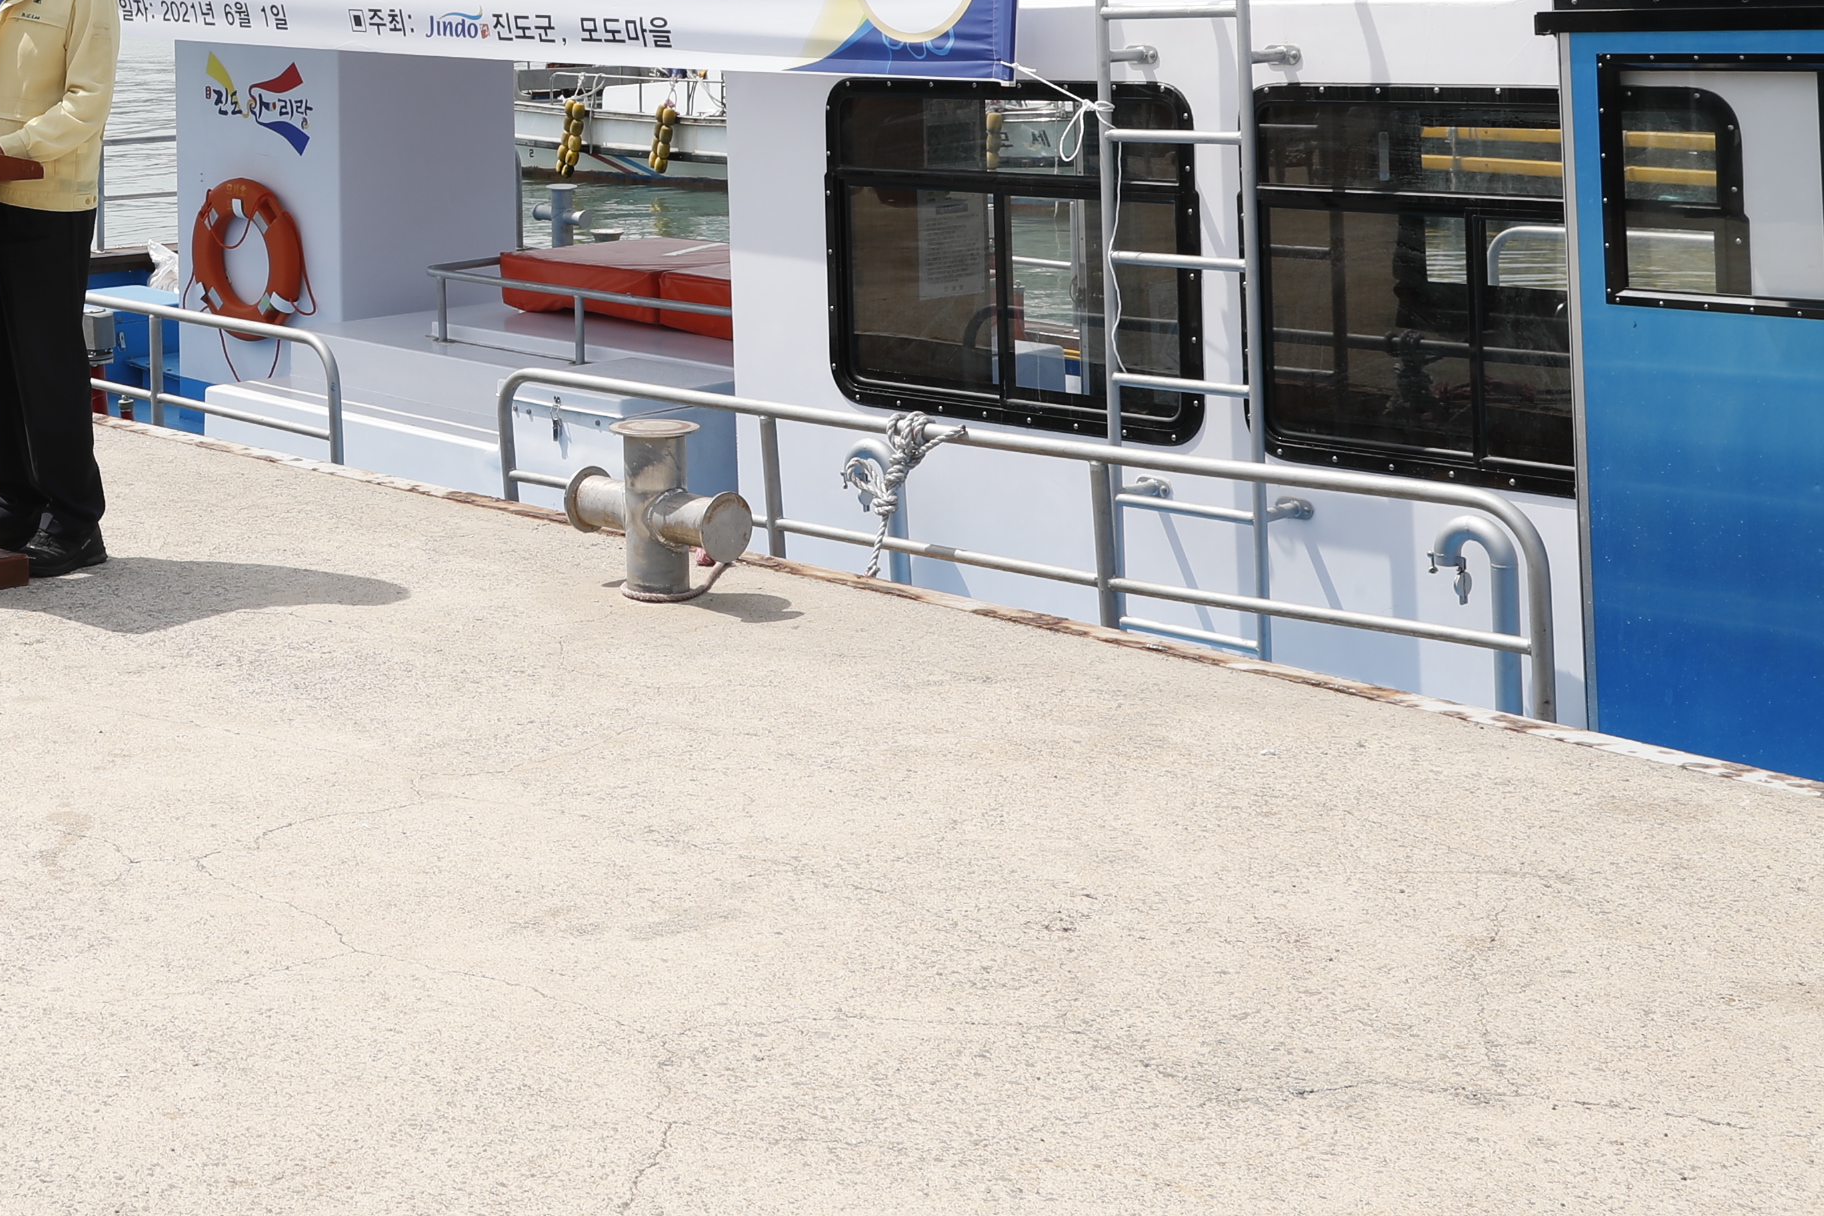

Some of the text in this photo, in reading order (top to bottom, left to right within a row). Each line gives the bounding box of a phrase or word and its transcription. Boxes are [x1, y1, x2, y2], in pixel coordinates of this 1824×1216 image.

[160, 0, 216, 27] 2021년
[223, 1, 253, 29] 6월
[260, 3, 289, 31] 1일
[425, 13, 479, 40] Jindo
[580, 16, 673, 48] 모도마을
